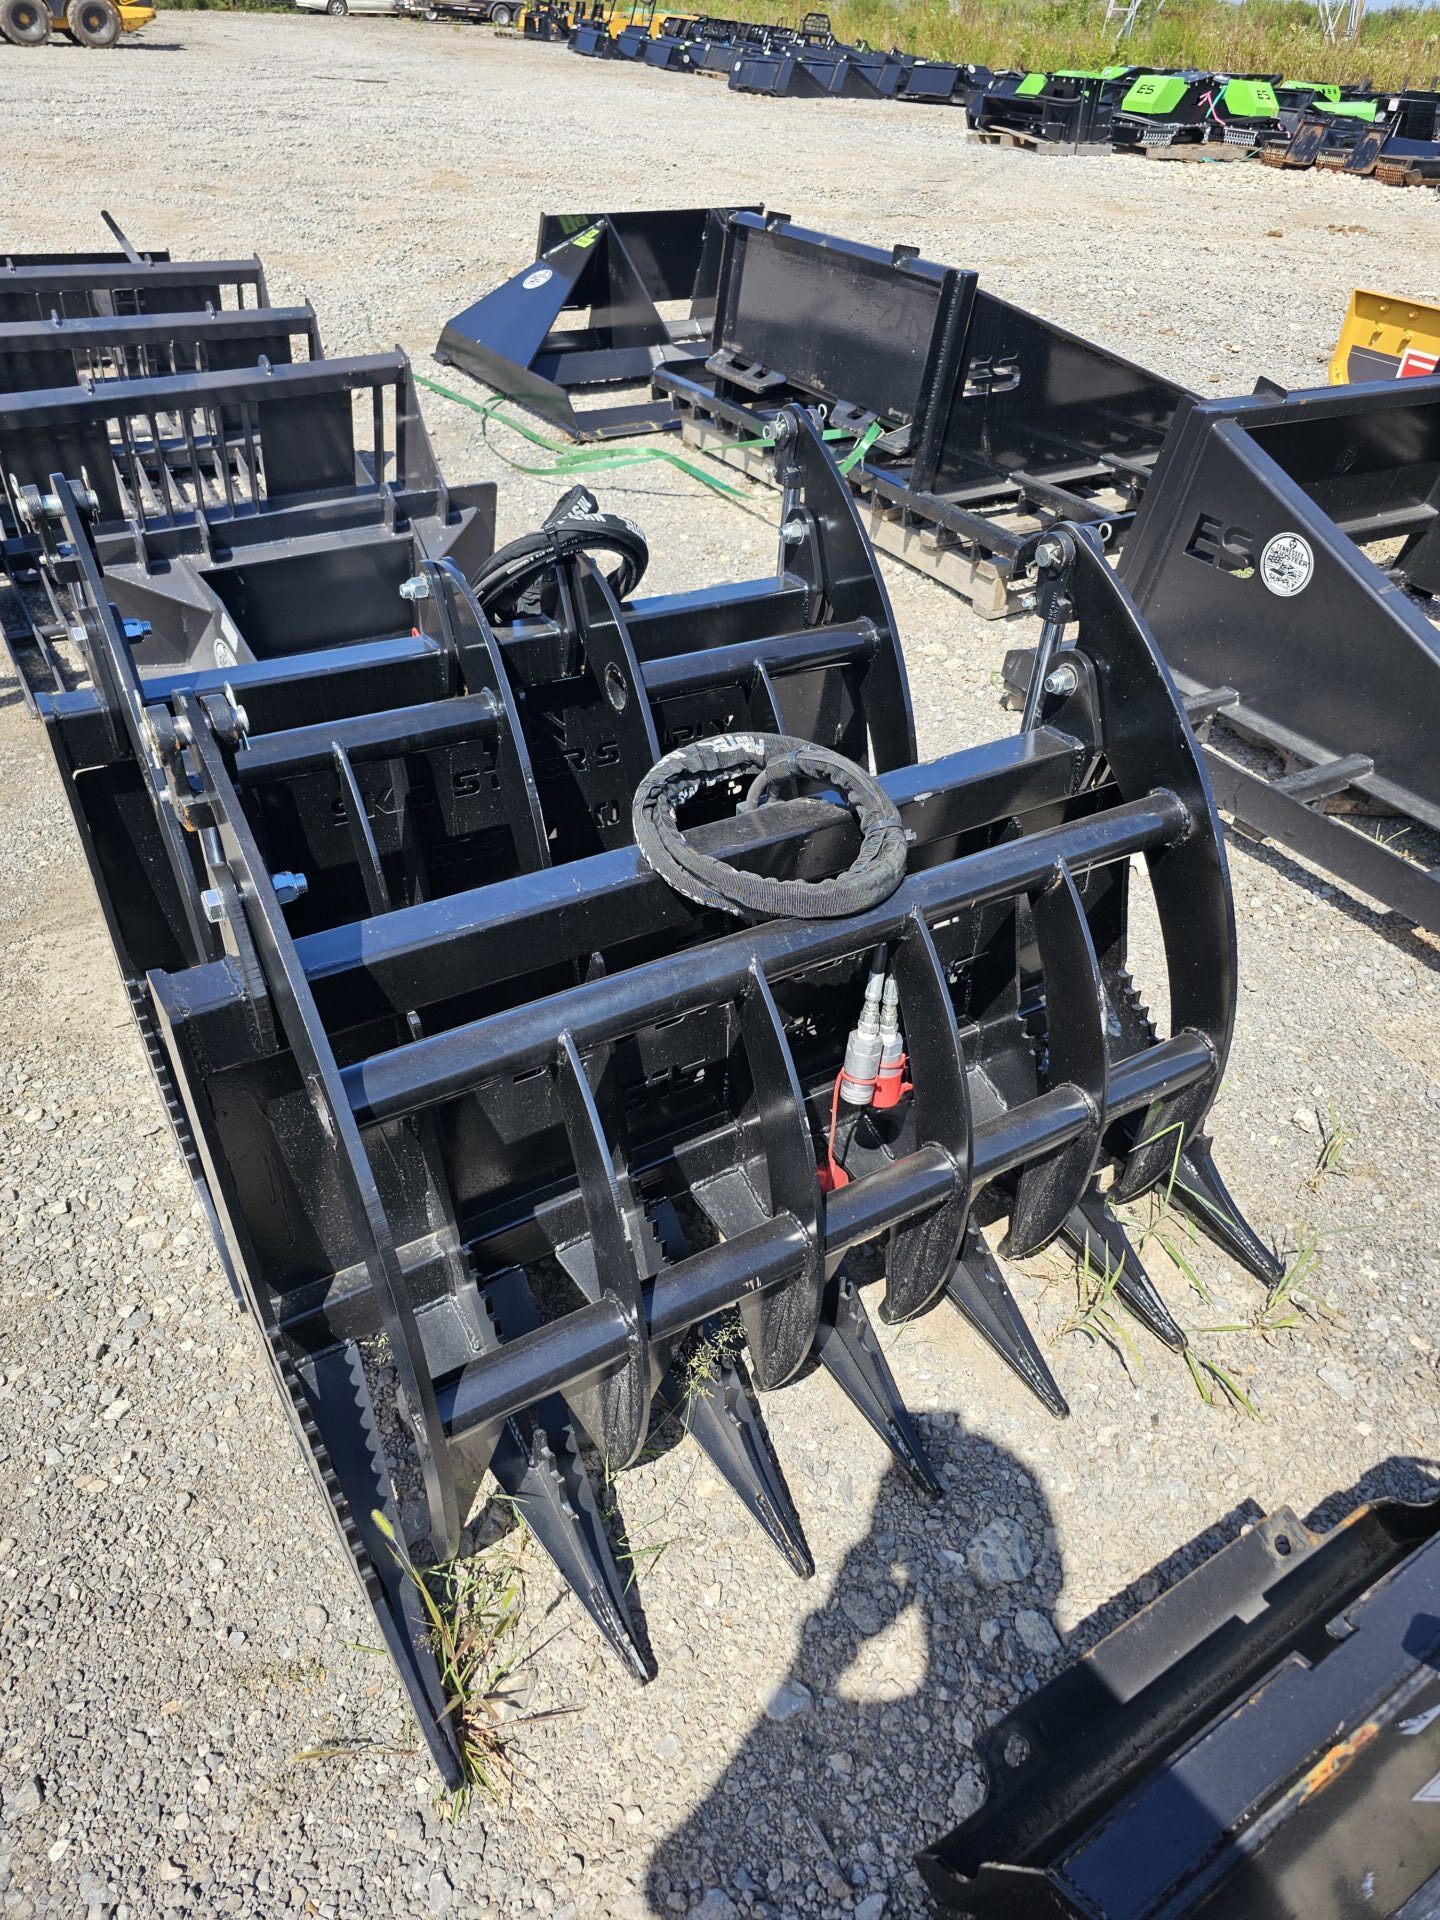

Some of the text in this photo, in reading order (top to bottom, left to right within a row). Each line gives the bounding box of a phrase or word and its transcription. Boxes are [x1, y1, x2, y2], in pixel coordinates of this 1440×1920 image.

[1136, 84, 1155, 95] ES
[1257, 89, 1271, 100] ES
[963, 351, 1021, 398] ES
[1182, 512, 1255, 579] ES
